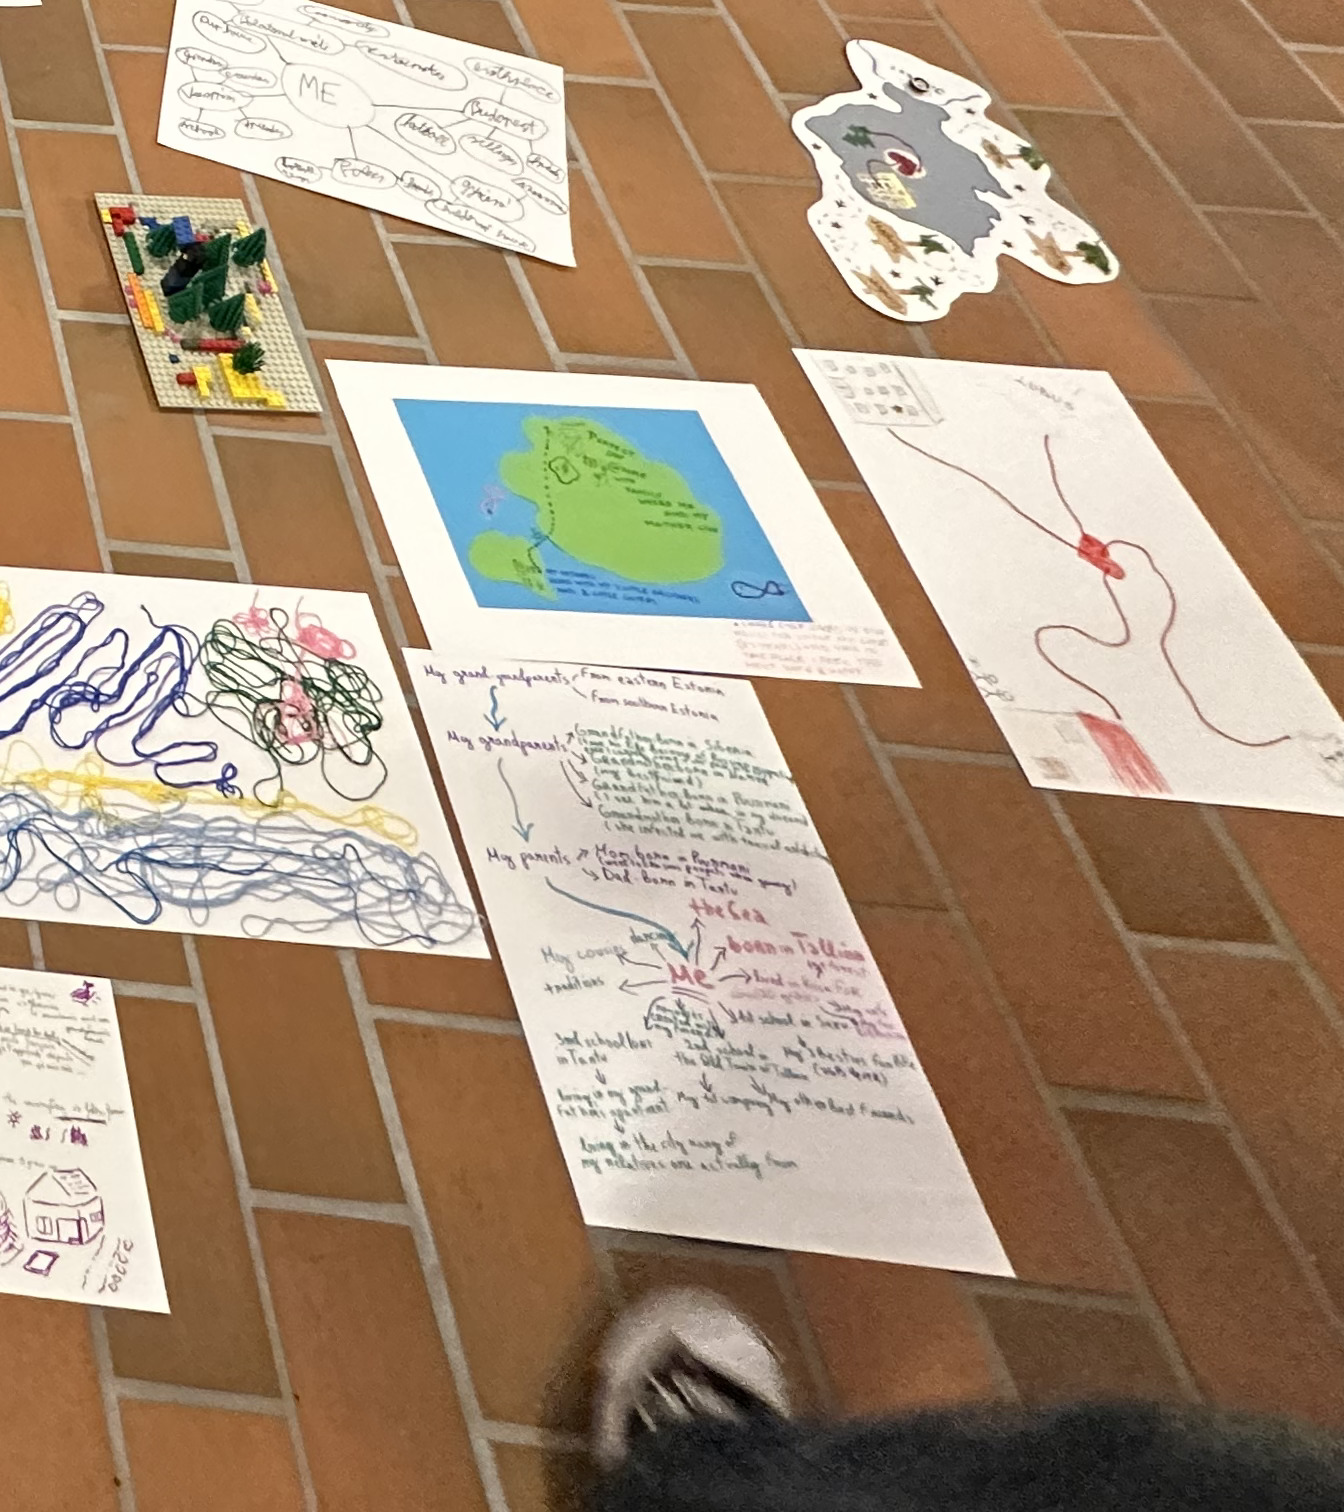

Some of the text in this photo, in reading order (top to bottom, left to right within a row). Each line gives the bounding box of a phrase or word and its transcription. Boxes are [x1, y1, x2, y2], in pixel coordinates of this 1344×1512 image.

[299, 73, 340, 105] ME
[424, 665, 447, 684] My
[453, 666, 495, 688] grand
[672, 676, 724, 696] Estonia
[670, 703, 719, 721] Estonia
[447, 731, 474, 750] My
[479, 728, 571, 762] grandparents
[486, 845, 517, 870] My
[520, 844, 573, 870] parents
